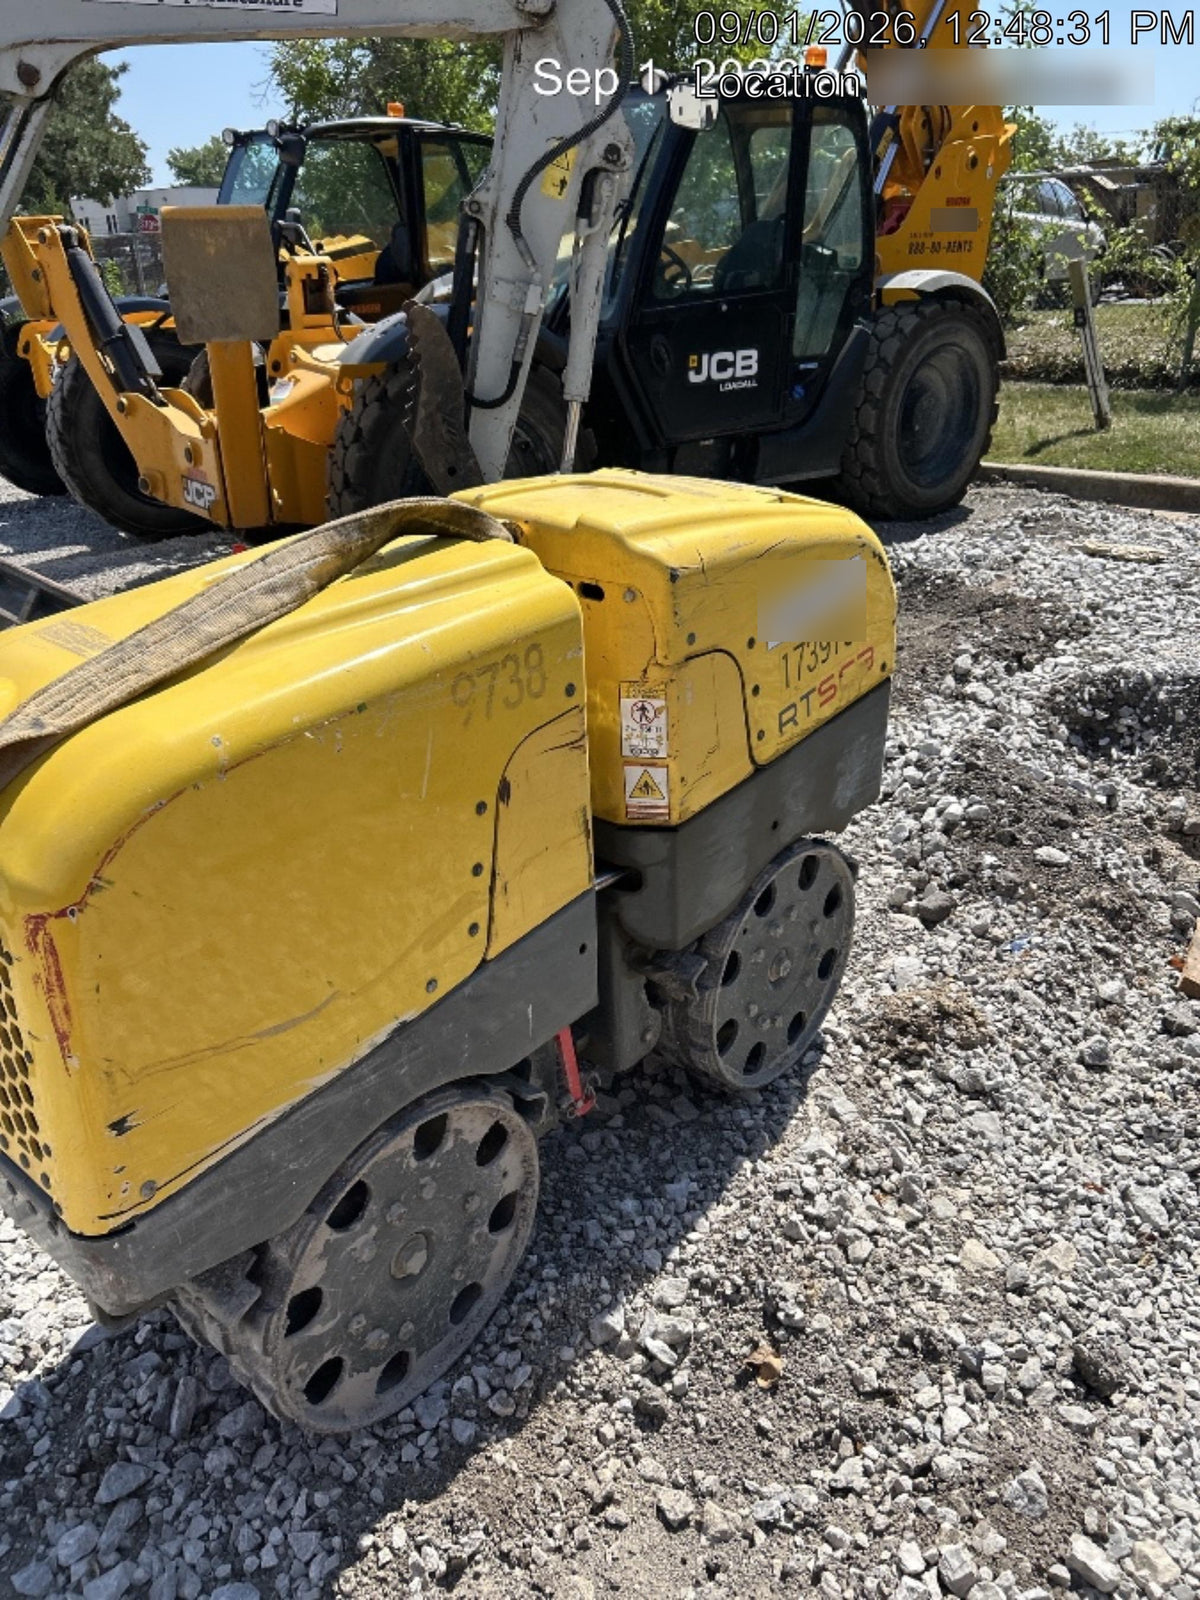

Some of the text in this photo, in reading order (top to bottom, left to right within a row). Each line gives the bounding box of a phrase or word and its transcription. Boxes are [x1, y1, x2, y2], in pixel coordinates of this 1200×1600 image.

[688, 349, 759, 383] JCB
[450, 642, 547, 728] 9738
[782, 641, 852, 688] 1739
